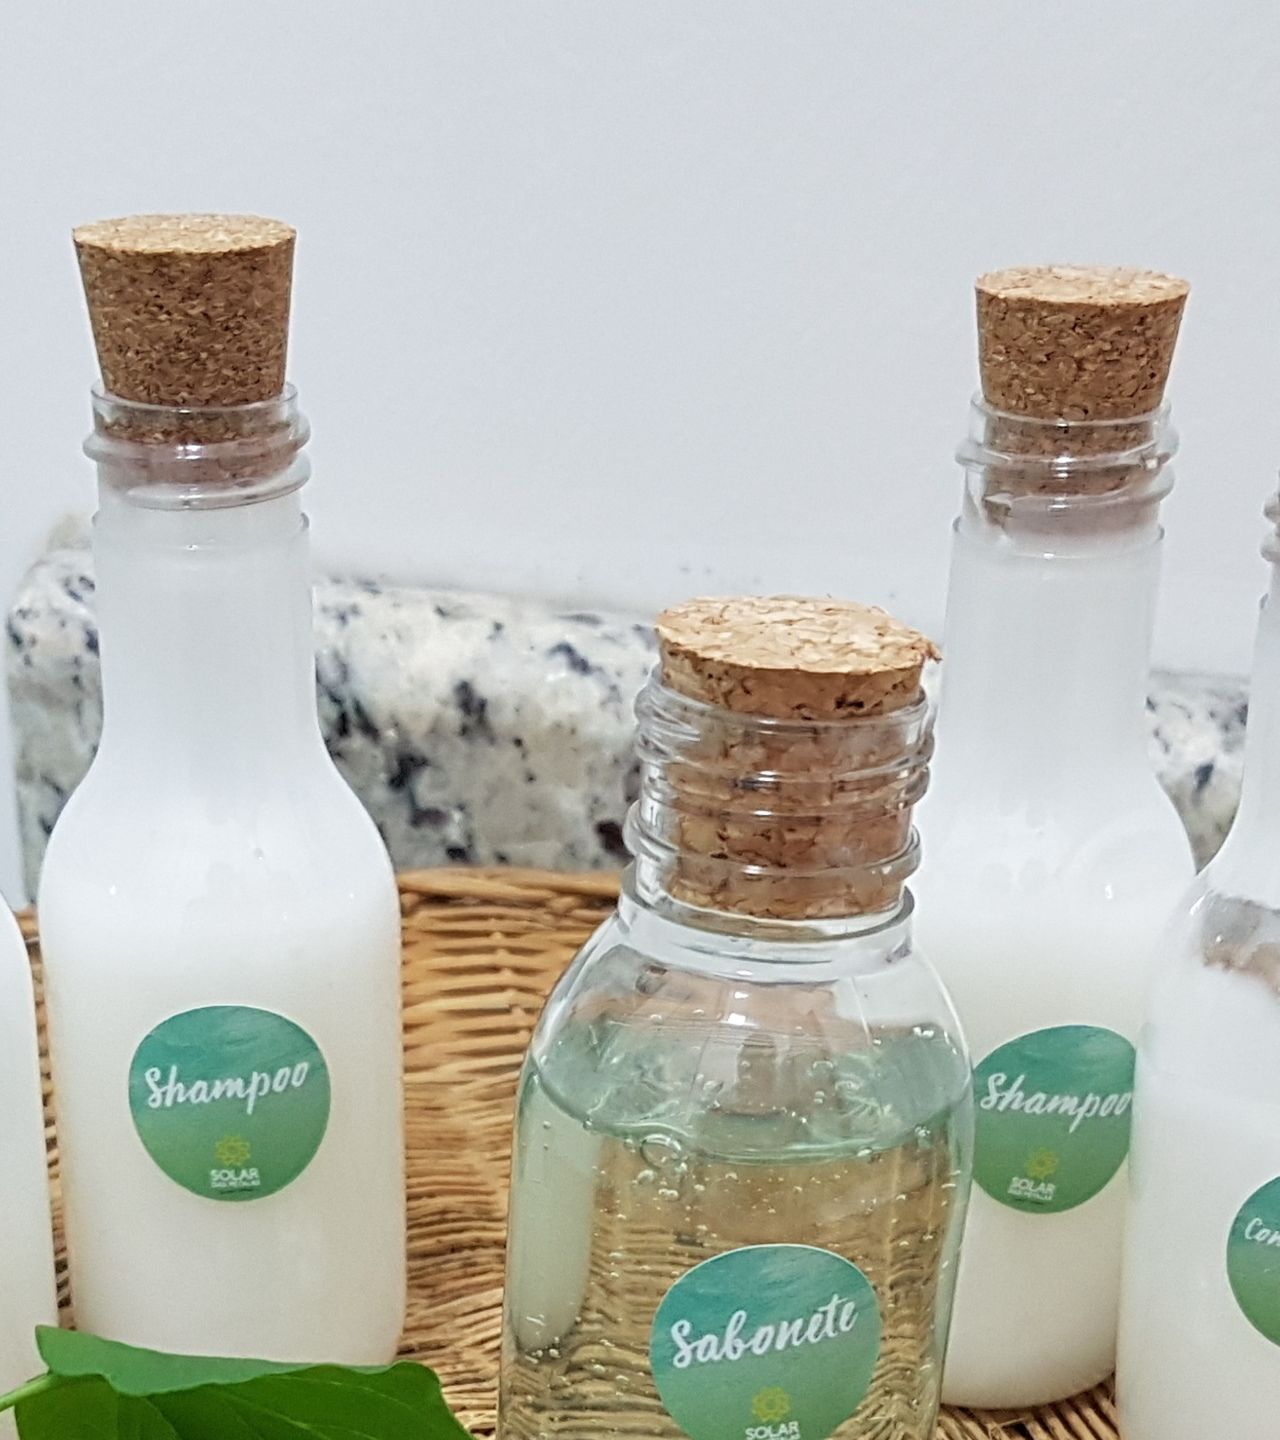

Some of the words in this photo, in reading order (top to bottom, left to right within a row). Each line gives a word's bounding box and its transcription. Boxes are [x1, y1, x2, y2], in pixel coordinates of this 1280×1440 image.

[144, 1062, 309, 1115] Shampoo
[979, 1072, 1132, 1134] Shampoo
[210, 1168, 259, 1181] SOLAR
[1011, 1177, 1055, 1194] SOLAR
[671, 1293, 859, 1368] Sabonete
[745, 1421, 799, 1440] SOLAR
